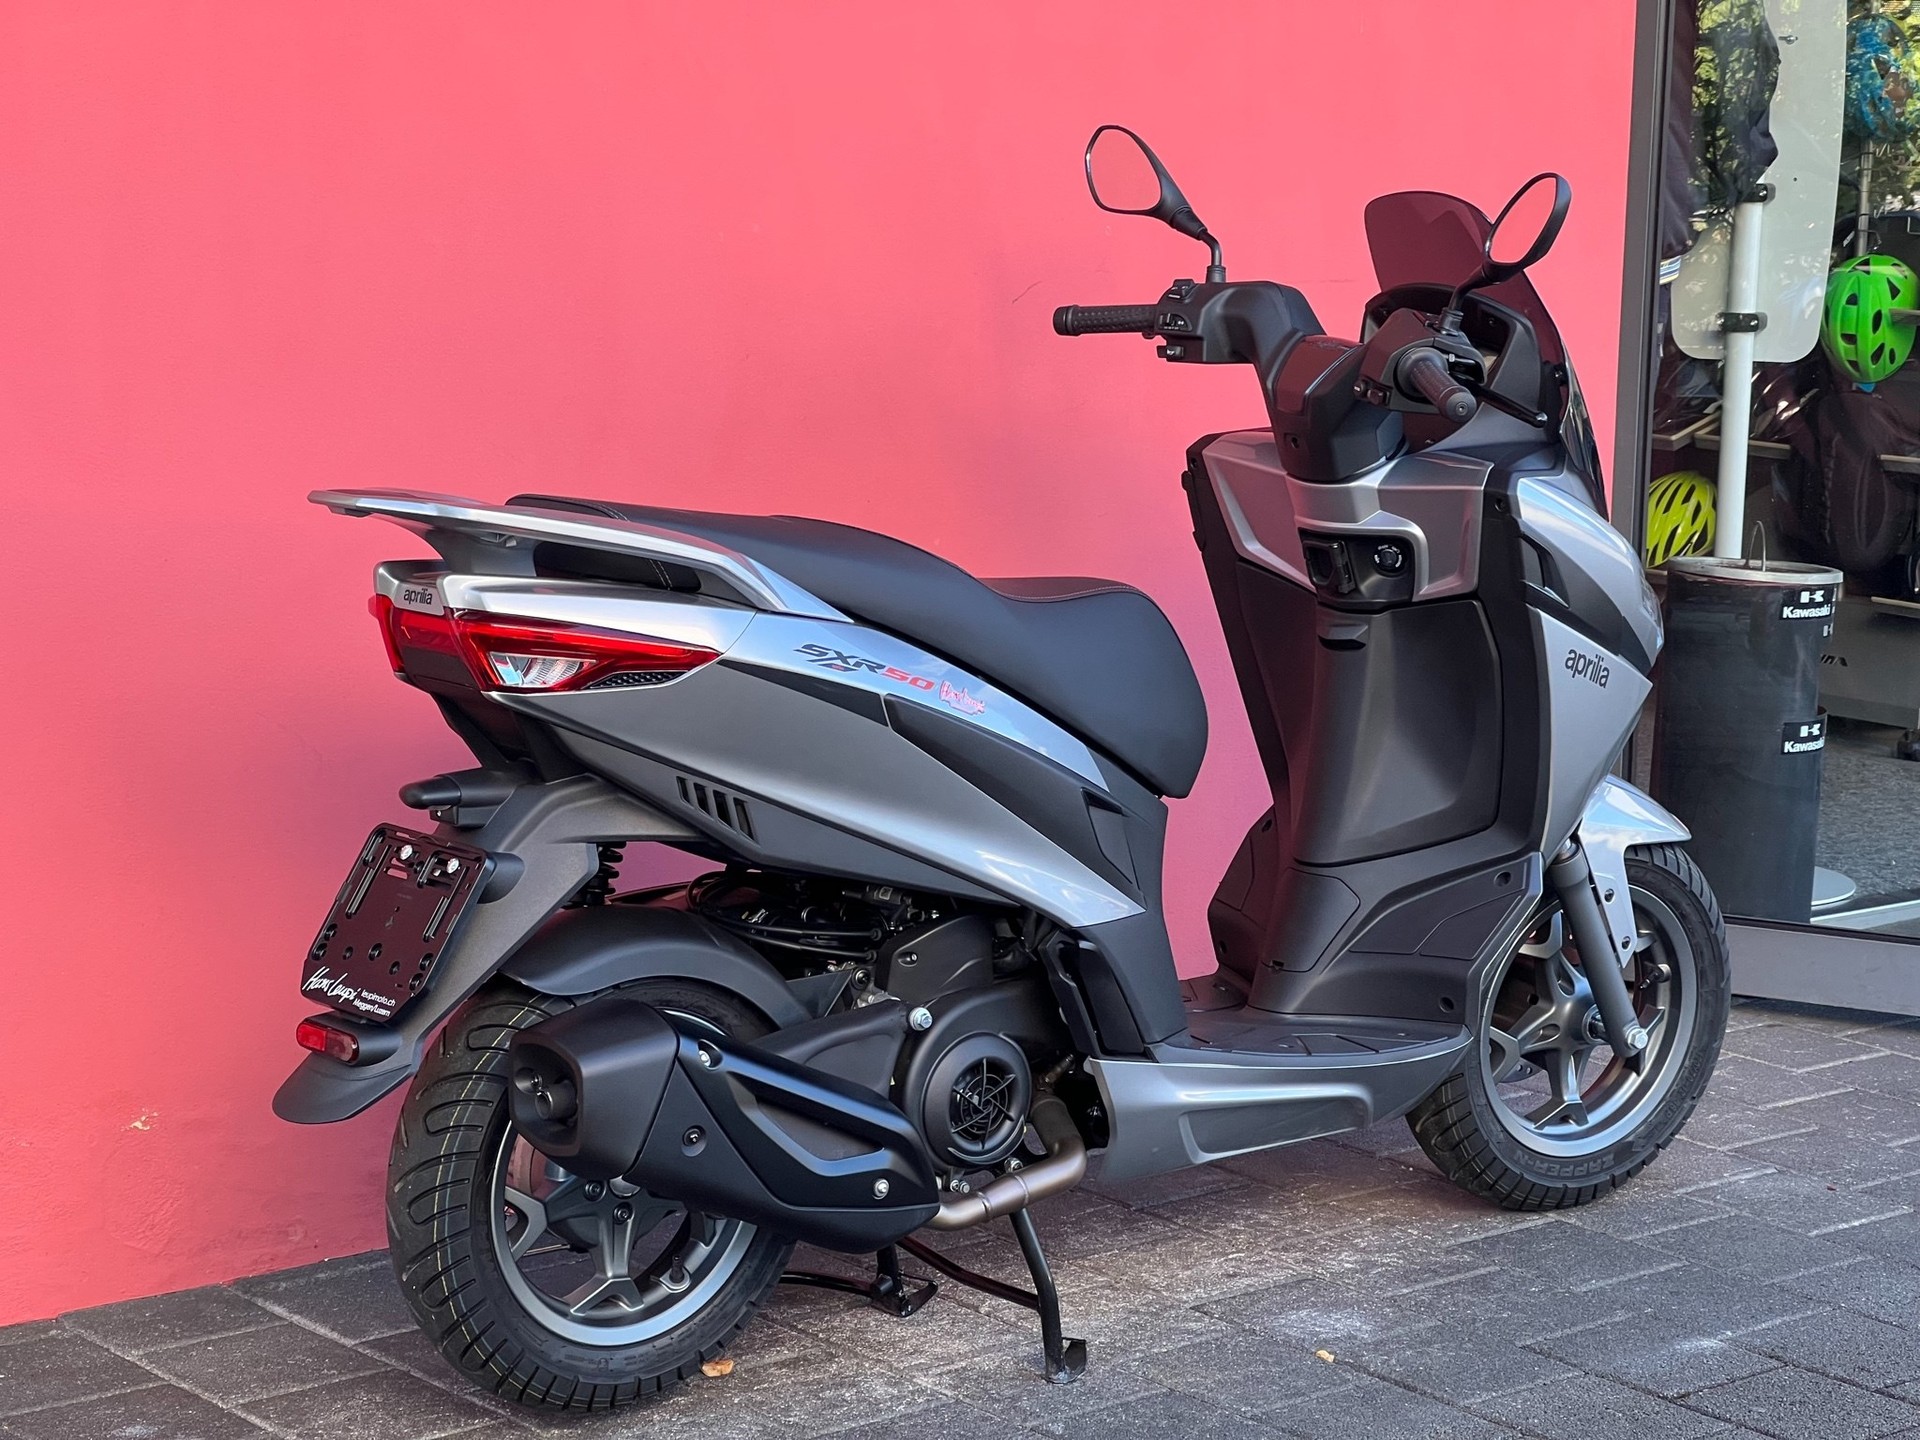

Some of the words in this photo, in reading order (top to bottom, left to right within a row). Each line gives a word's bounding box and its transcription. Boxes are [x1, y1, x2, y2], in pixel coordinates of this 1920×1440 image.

[403, 587, 433, 606] aprilia
[1782, 604, 1831, 619] Kawasaki
[1564, 648, 1611, 689] aprilia
[1783, 736, 1825, 753] Kawasaki
[361, 989, 396, 1007] leupimoto.ch
[1513, 1149, 1615, 1177] ZAPPER-N
